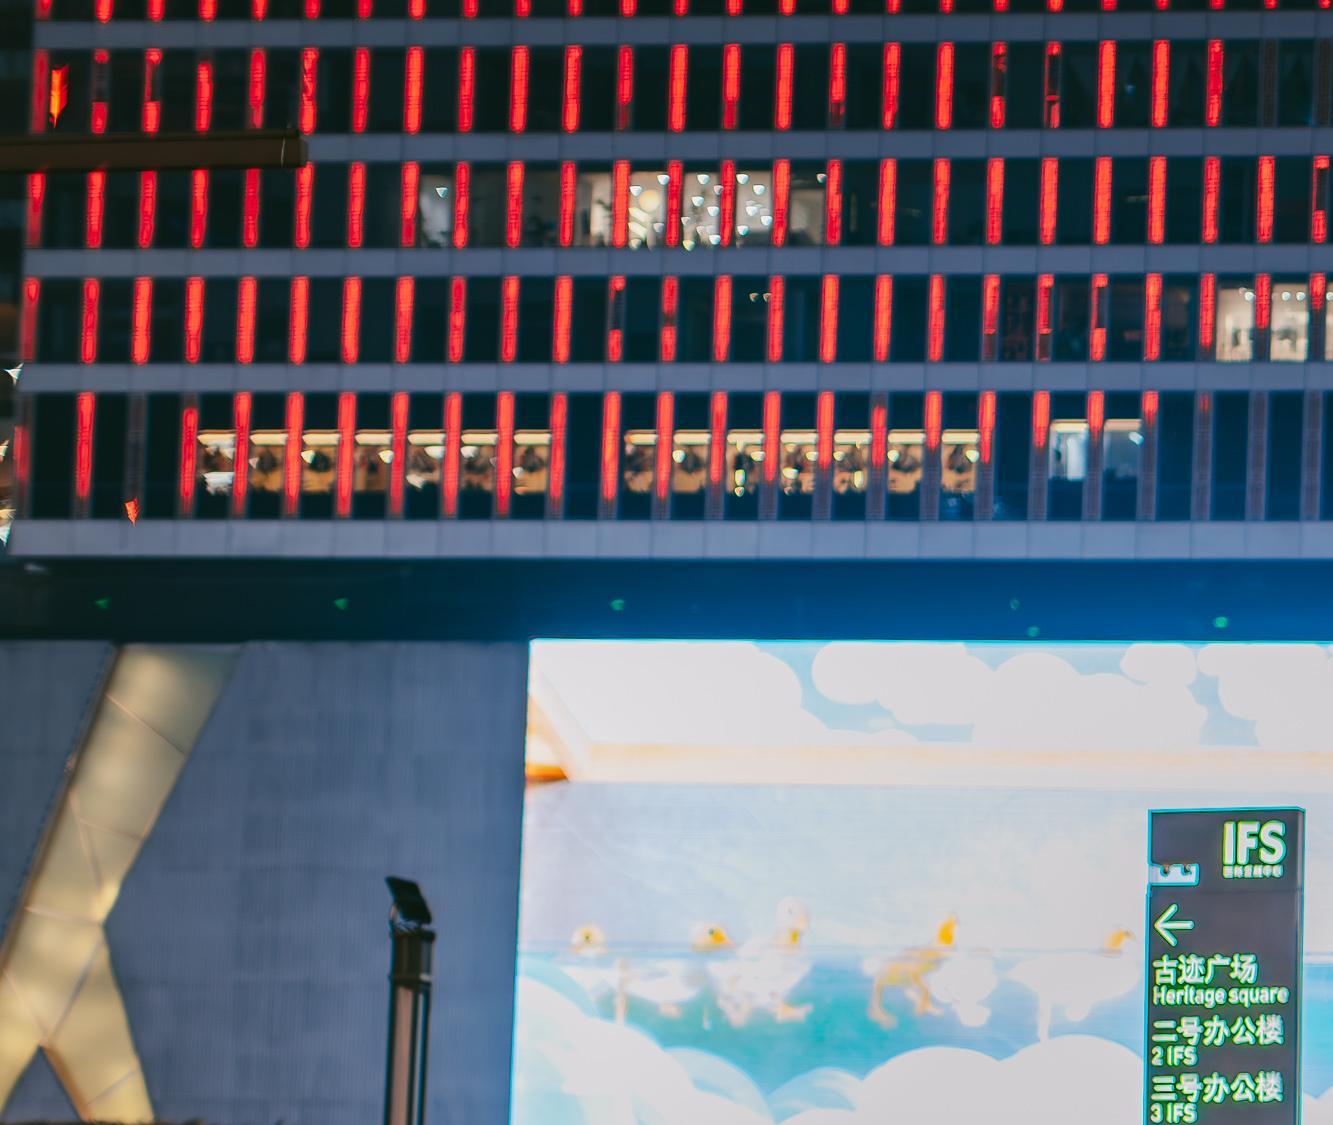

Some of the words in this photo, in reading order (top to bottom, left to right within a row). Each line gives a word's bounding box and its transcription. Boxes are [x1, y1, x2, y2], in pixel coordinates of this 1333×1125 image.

[1223, 820, 1287, 865] IFS
[1152, 953, 1260, 986] 古迹广场
[1152, 985, 1227, 1009] Heritage
[1228, 986, 1290, 1008] square
[1151, 1013, 1285, 1047] 二号办公楼
[1151, 1045, 1164, 1066] 2
[1167, 1045, 1198, 1066] IFS
[1150, 1070, 1284, 1103] 三号办公楼
[1150, 1102, 1164, 1124] 3
[1166, 1102, 1198, 1124] IFS
